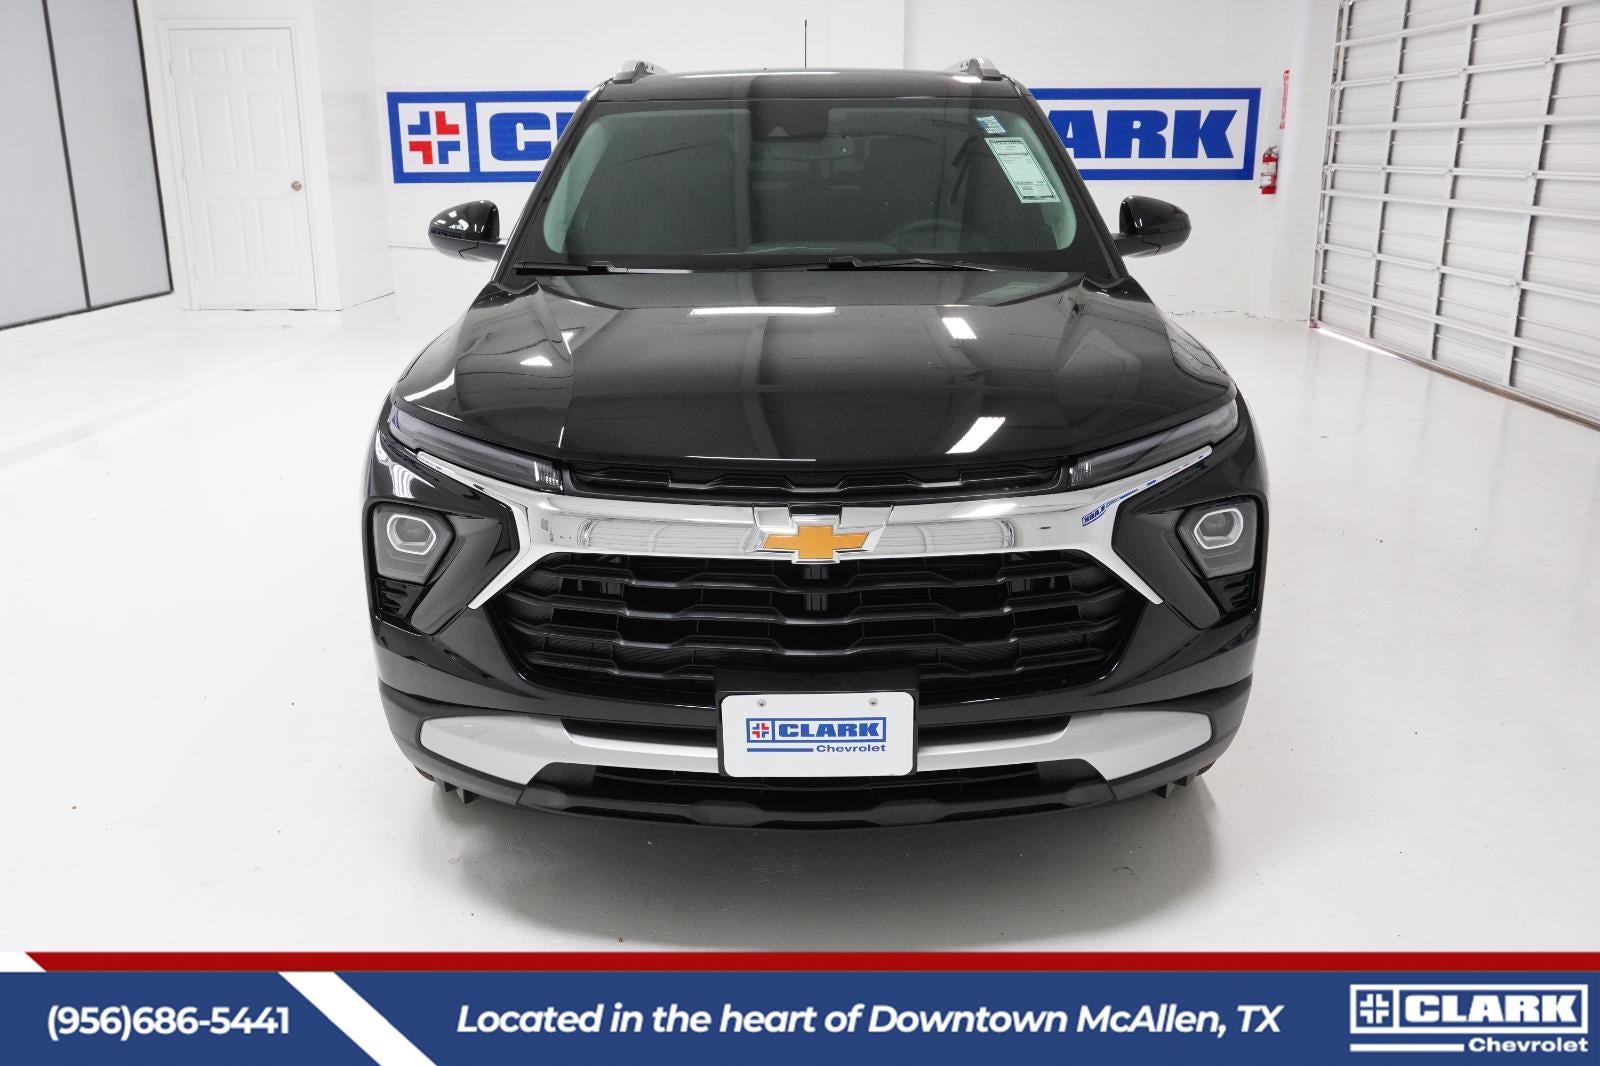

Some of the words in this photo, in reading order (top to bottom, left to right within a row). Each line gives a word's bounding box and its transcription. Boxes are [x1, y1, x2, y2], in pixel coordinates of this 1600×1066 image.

[1048, 110, 1237, 159] ARK
[778, 722, 880, 738] CLARK
[816, 744, 887, 753] Chevrolet
